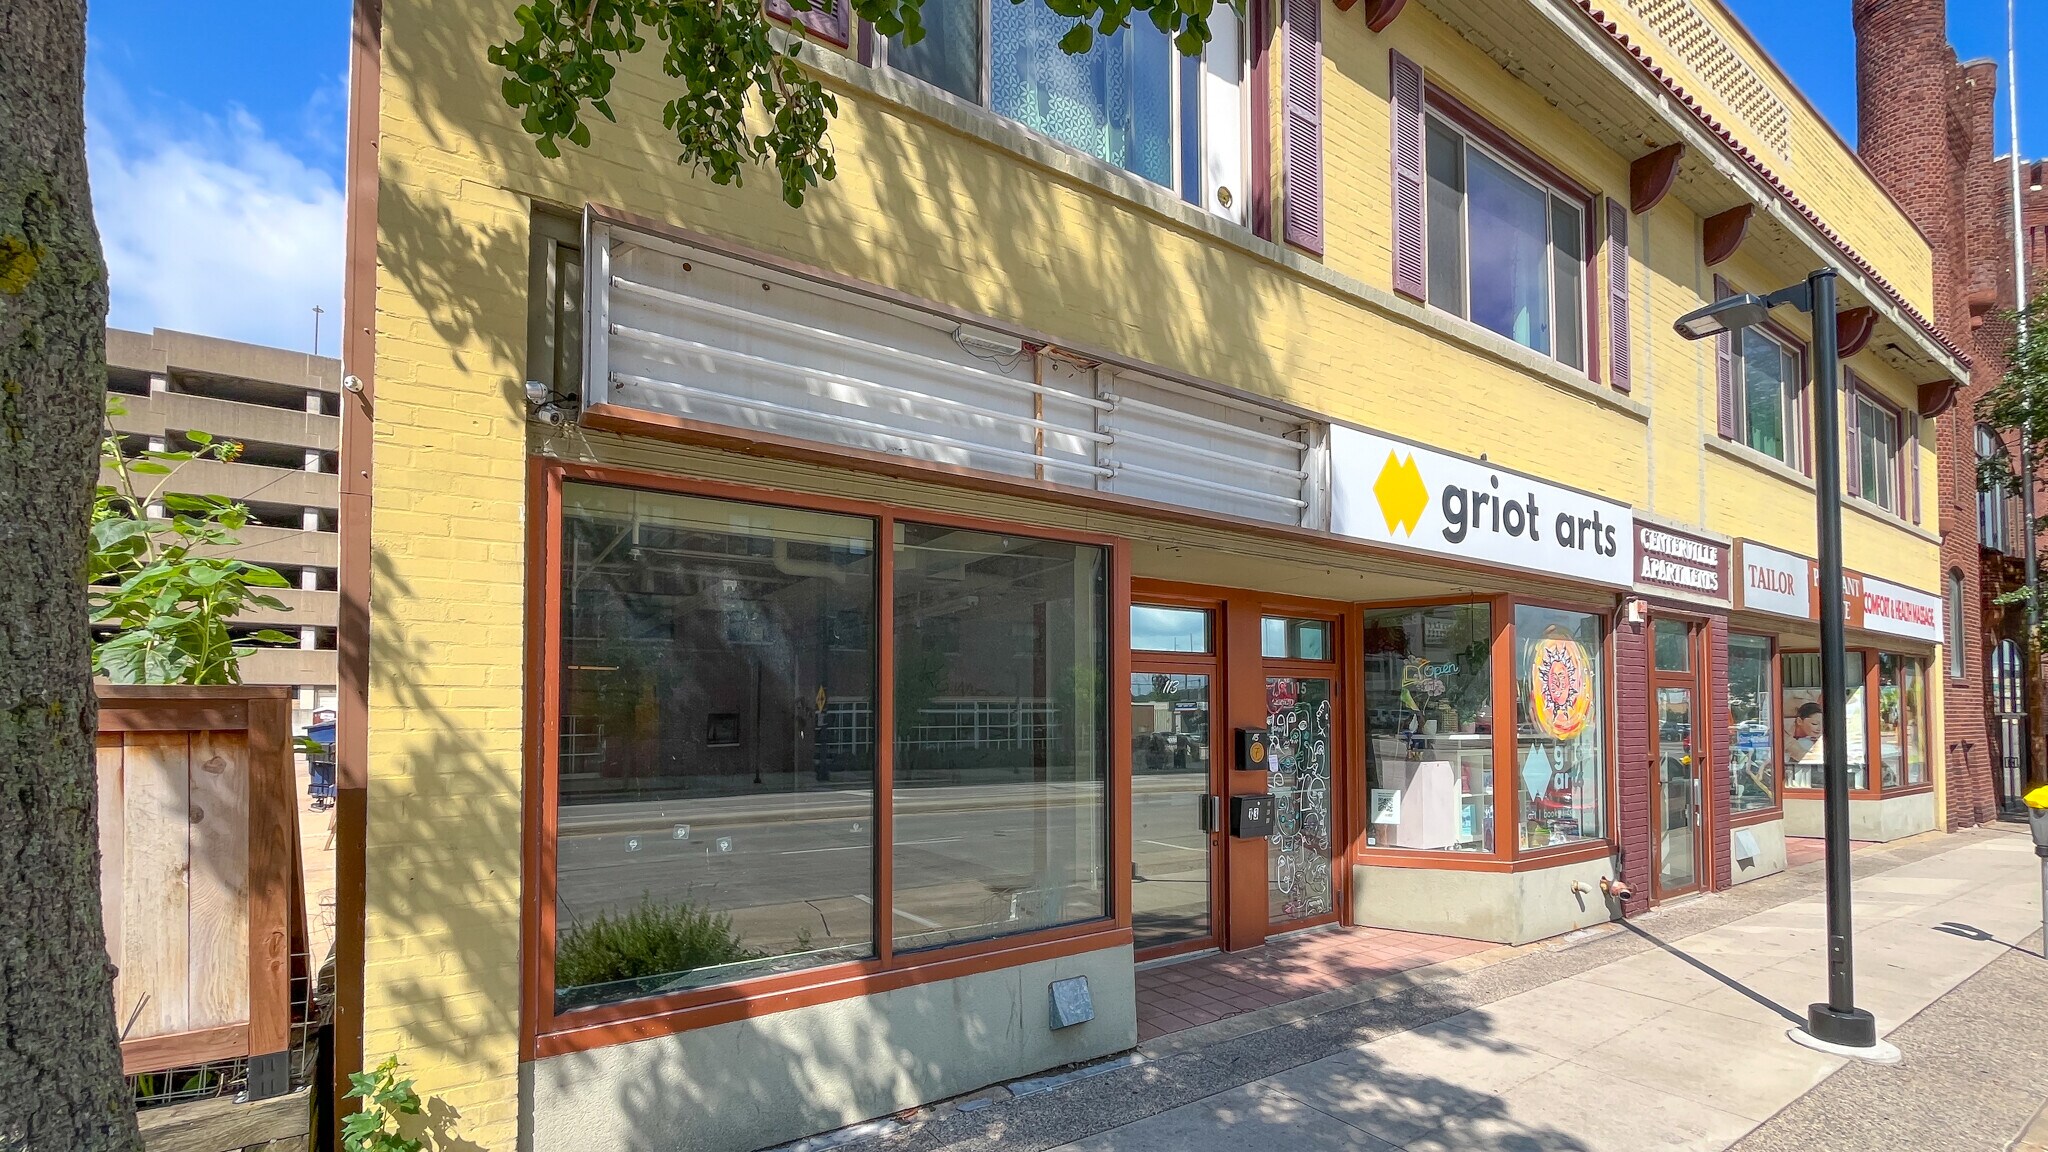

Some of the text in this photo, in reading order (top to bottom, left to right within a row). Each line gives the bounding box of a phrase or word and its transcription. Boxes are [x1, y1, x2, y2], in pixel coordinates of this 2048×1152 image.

[1441, 474, 1617, 558] griot arts
[1640, 527, 1719, 566] CENTERVILLE
[1640, 555, 1719, 591] APARTMENTS
[1748, 564, 1795, 596] TAILOR
[1864, 591, 1890, 618] COMFORT
[1162, 680, 1180, 694] 113
[1424, 663, 1460, 679] Open
